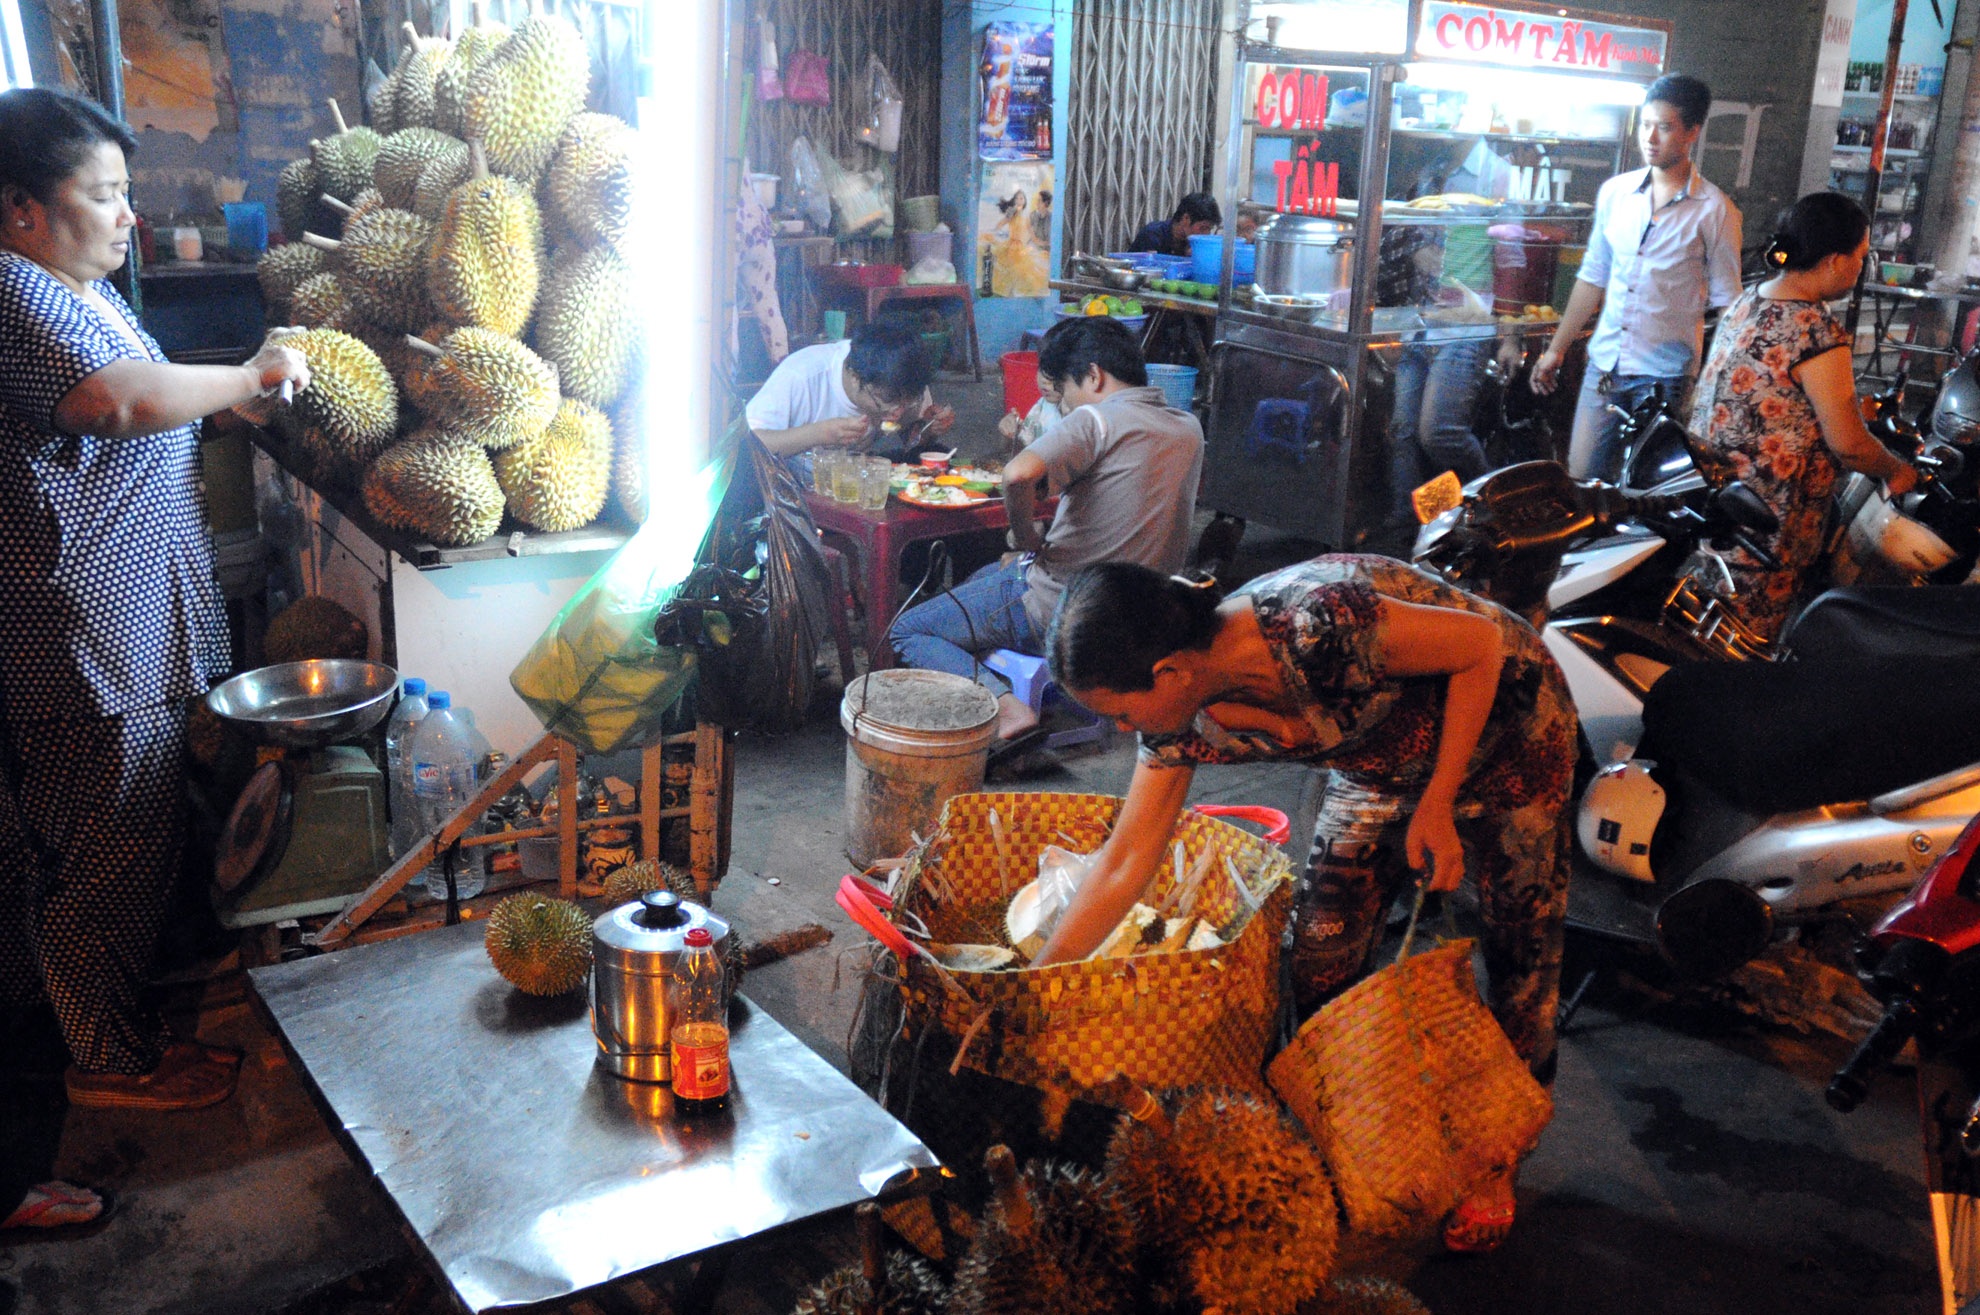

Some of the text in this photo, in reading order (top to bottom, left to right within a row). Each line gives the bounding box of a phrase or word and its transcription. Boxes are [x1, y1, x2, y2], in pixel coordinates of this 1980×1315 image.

[1436, 10, 1525, 53] CƠM
[1529, 20, 1613, 68] TẤM
[1257, 68, 1329, 130] CƠM
[1273, 140, 1340, 217] TẤM
